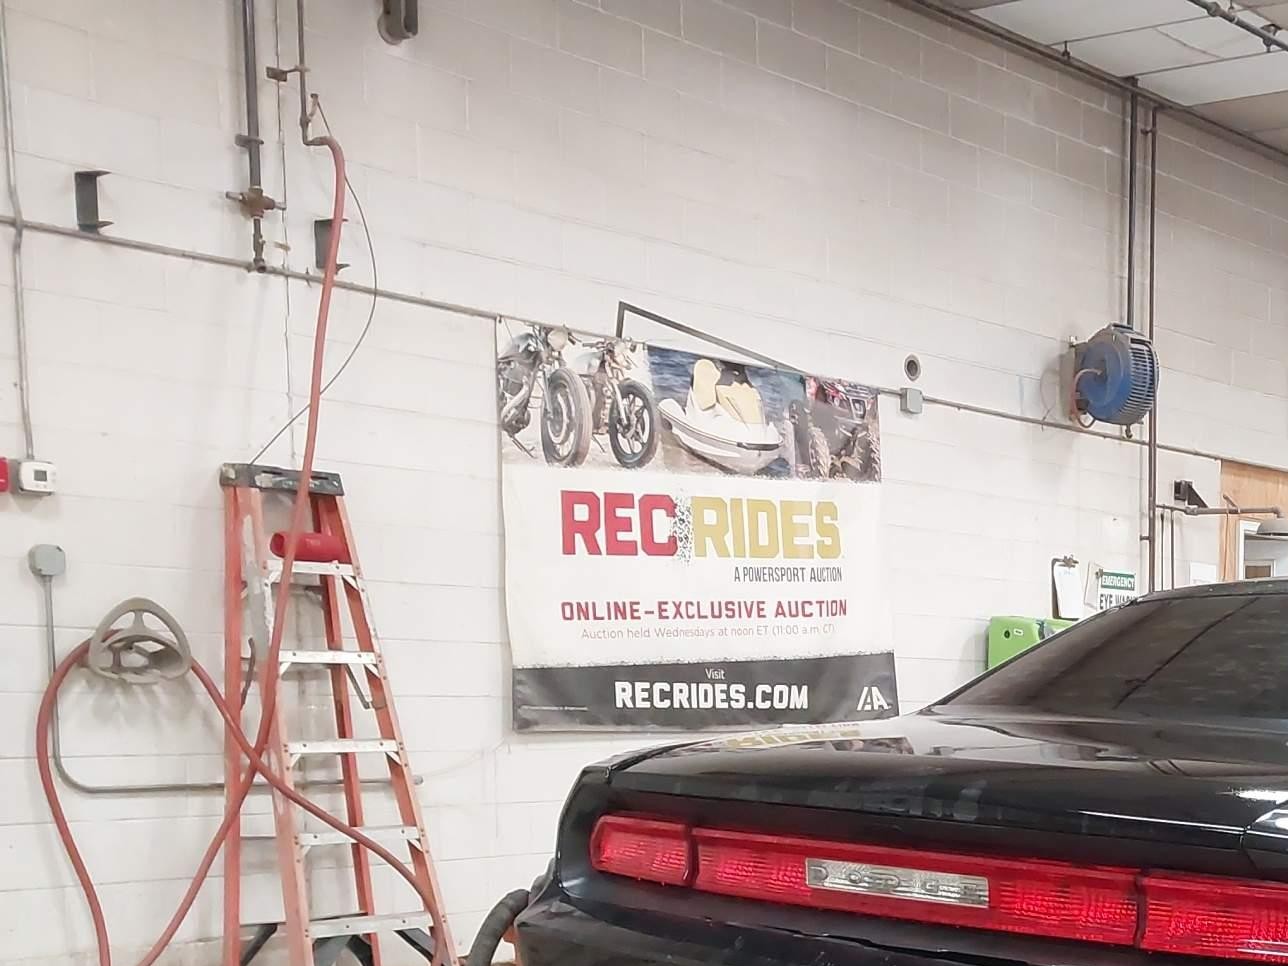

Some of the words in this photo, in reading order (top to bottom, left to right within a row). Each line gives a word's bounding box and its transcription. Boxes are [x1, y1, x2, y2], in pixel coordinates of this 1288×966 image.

[561, 490, 678, 556] REC
[691, 496, 842, 559] RIDES
[734, 567, 741, 582] A
[743, 567, 806, 582] POWERSPORT
[809, 567, 842, 582] AUCTION
[1101, 575, 1135, 589] EMERGENCY
[1100, 593, 1112, 610] EYE
[561, 601, 767, 621] ONLINE-EXCLUSIVE
[774, 599, 847, 619] AUCTION
[582, 628, 624, 640] Auction
[626, 627, 650, 639] held
[654, 626, 715, 640] Wednesdays
[718, 627, 728, 637] at
[731, 626, 754, 636] noon
[756, 624, 768, 635] ET
[705, 668, 725, 680] Visit
[614, 681, 809, 710] RECRIDES.COM
